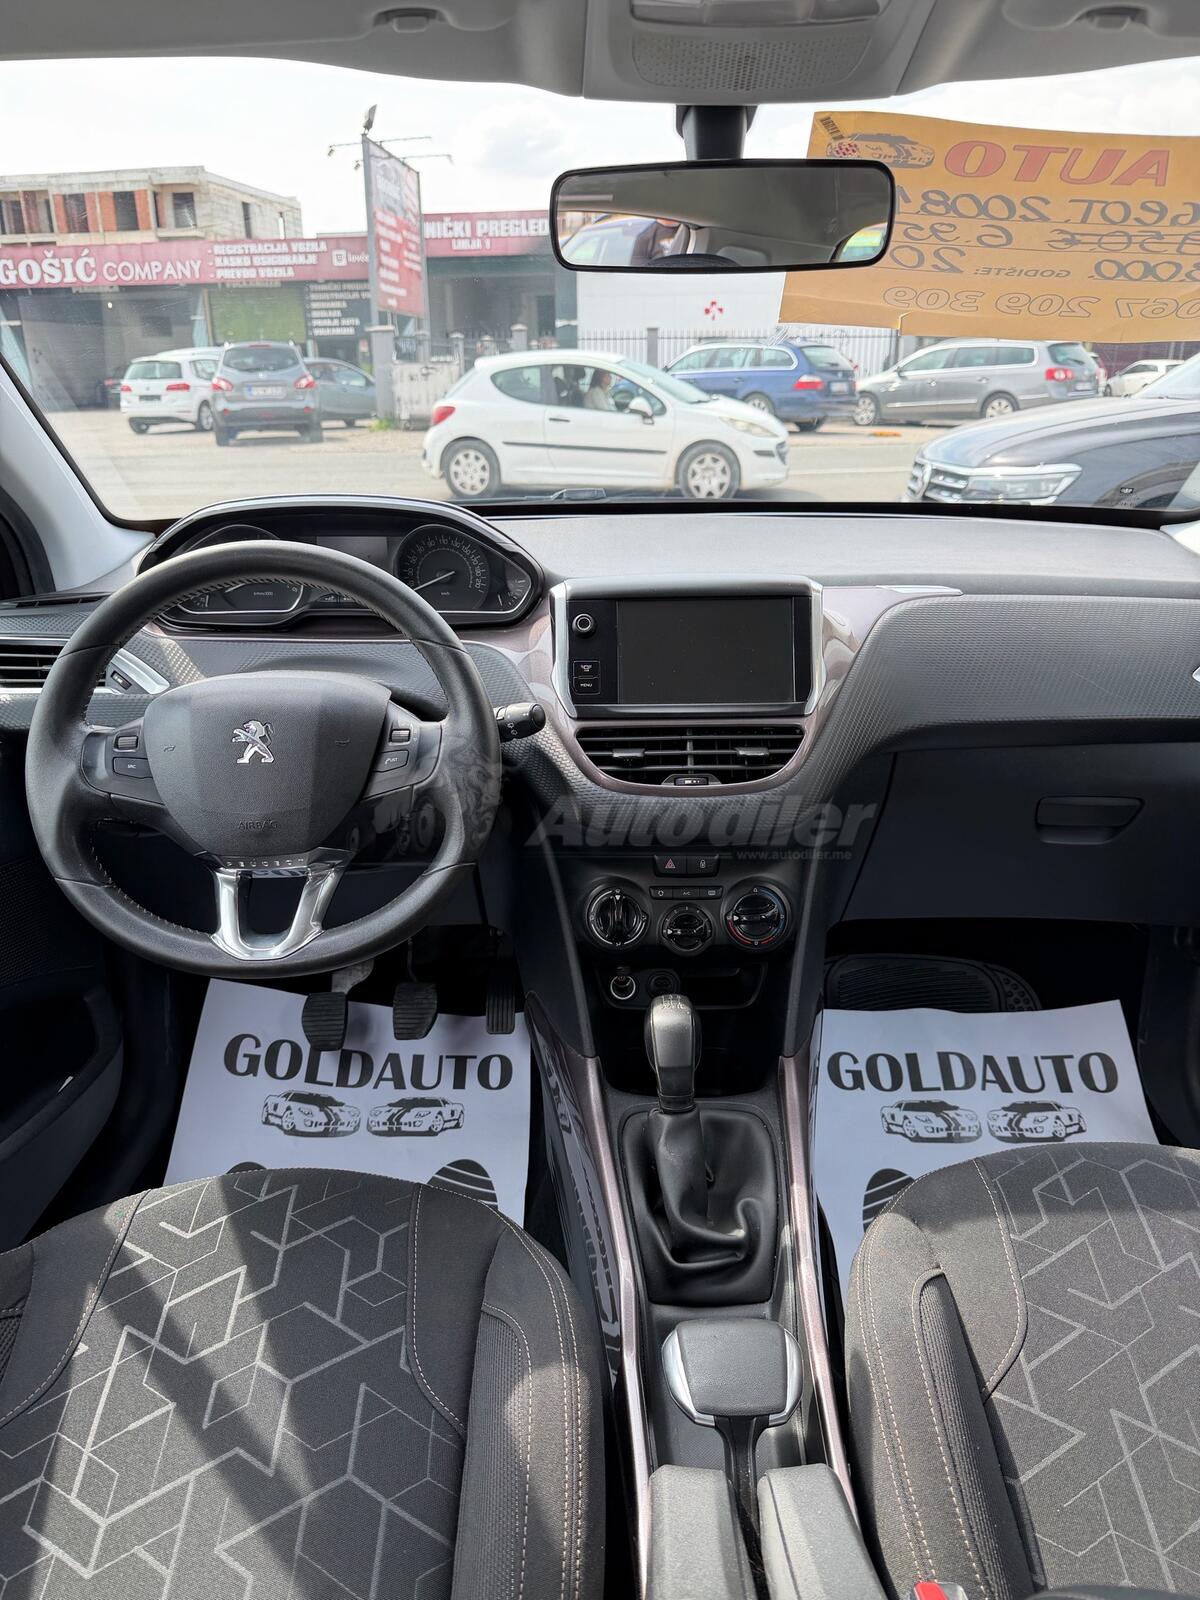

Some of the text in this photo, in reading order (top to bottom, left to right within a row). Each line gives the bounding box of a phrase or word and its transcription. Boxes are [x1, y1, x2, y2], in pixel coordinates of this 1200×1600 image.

[476, 218, 550, 237] PREGLED
[0, 248, 201, 285] GOŠIĆ COMPANY
[238, 821, 280, 831] AIRBAG
[223, 1033, 513, 1090] GOLDAUTO
[827, 1051, 1119, 1094] GOLDAUTO
